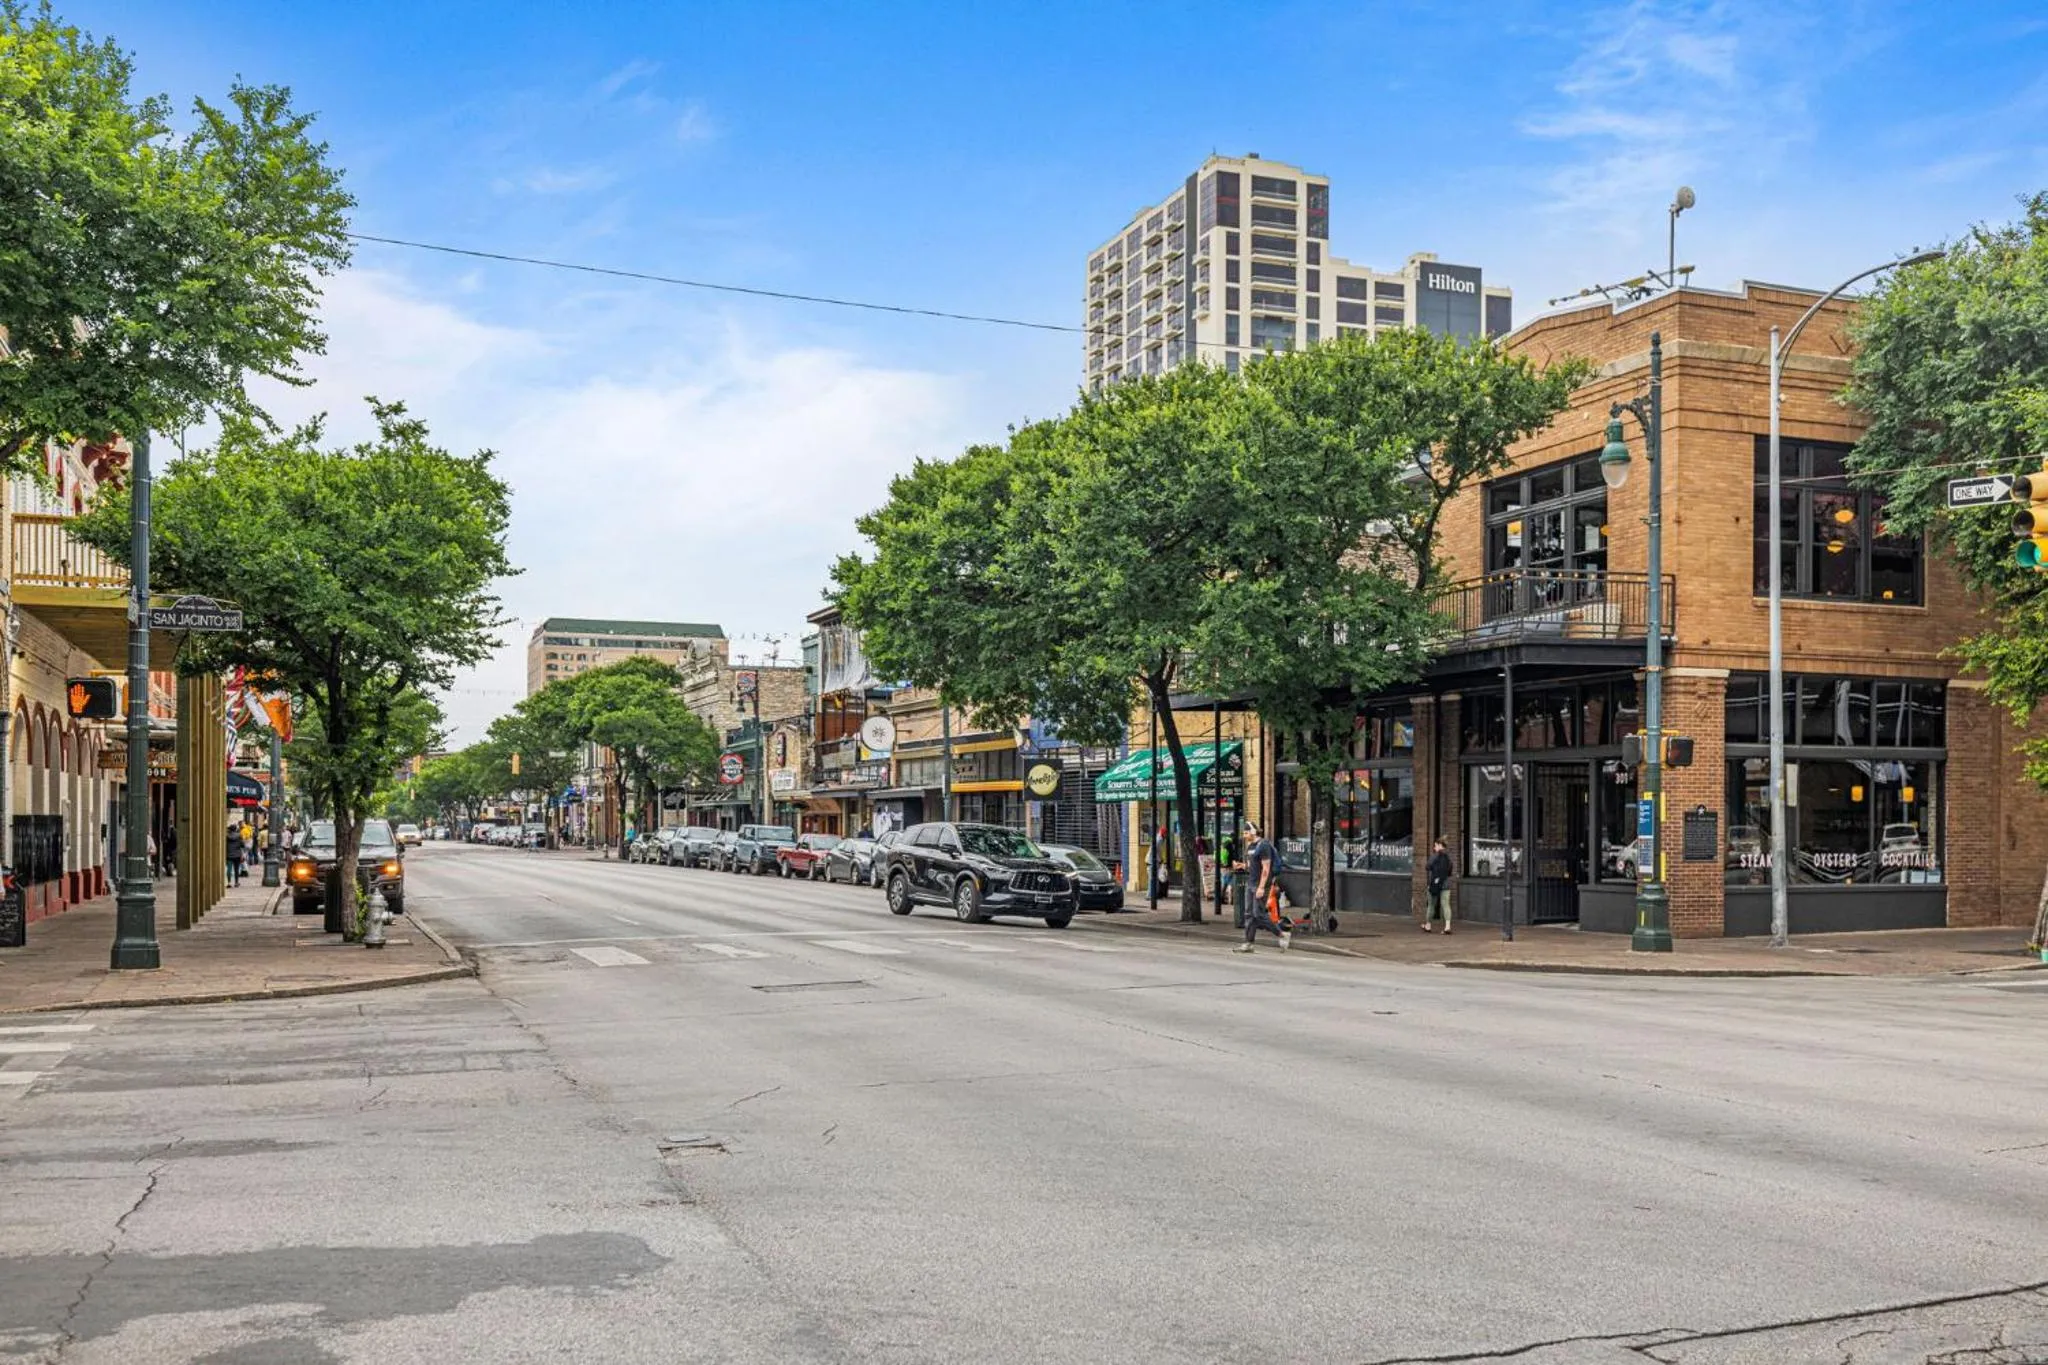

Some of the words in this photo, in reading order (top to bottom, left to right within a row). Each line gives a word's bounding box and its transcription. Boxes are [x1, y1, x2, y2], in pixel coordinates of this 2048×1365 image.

[1428, 273, 1475, 294] Hilton
[1955, 488, 1973, 499] ONE
[1975, 485, 1994, 495] WAY
[153, 612, 176, 625] SAN
[178, 614, 223, 626] JACINTO
[1740, 853, 1773, 868] STEAK
[1813, 853, 1858, 868] OYSTERS
[1881, 853, 1936, 868] COCKTAILS
